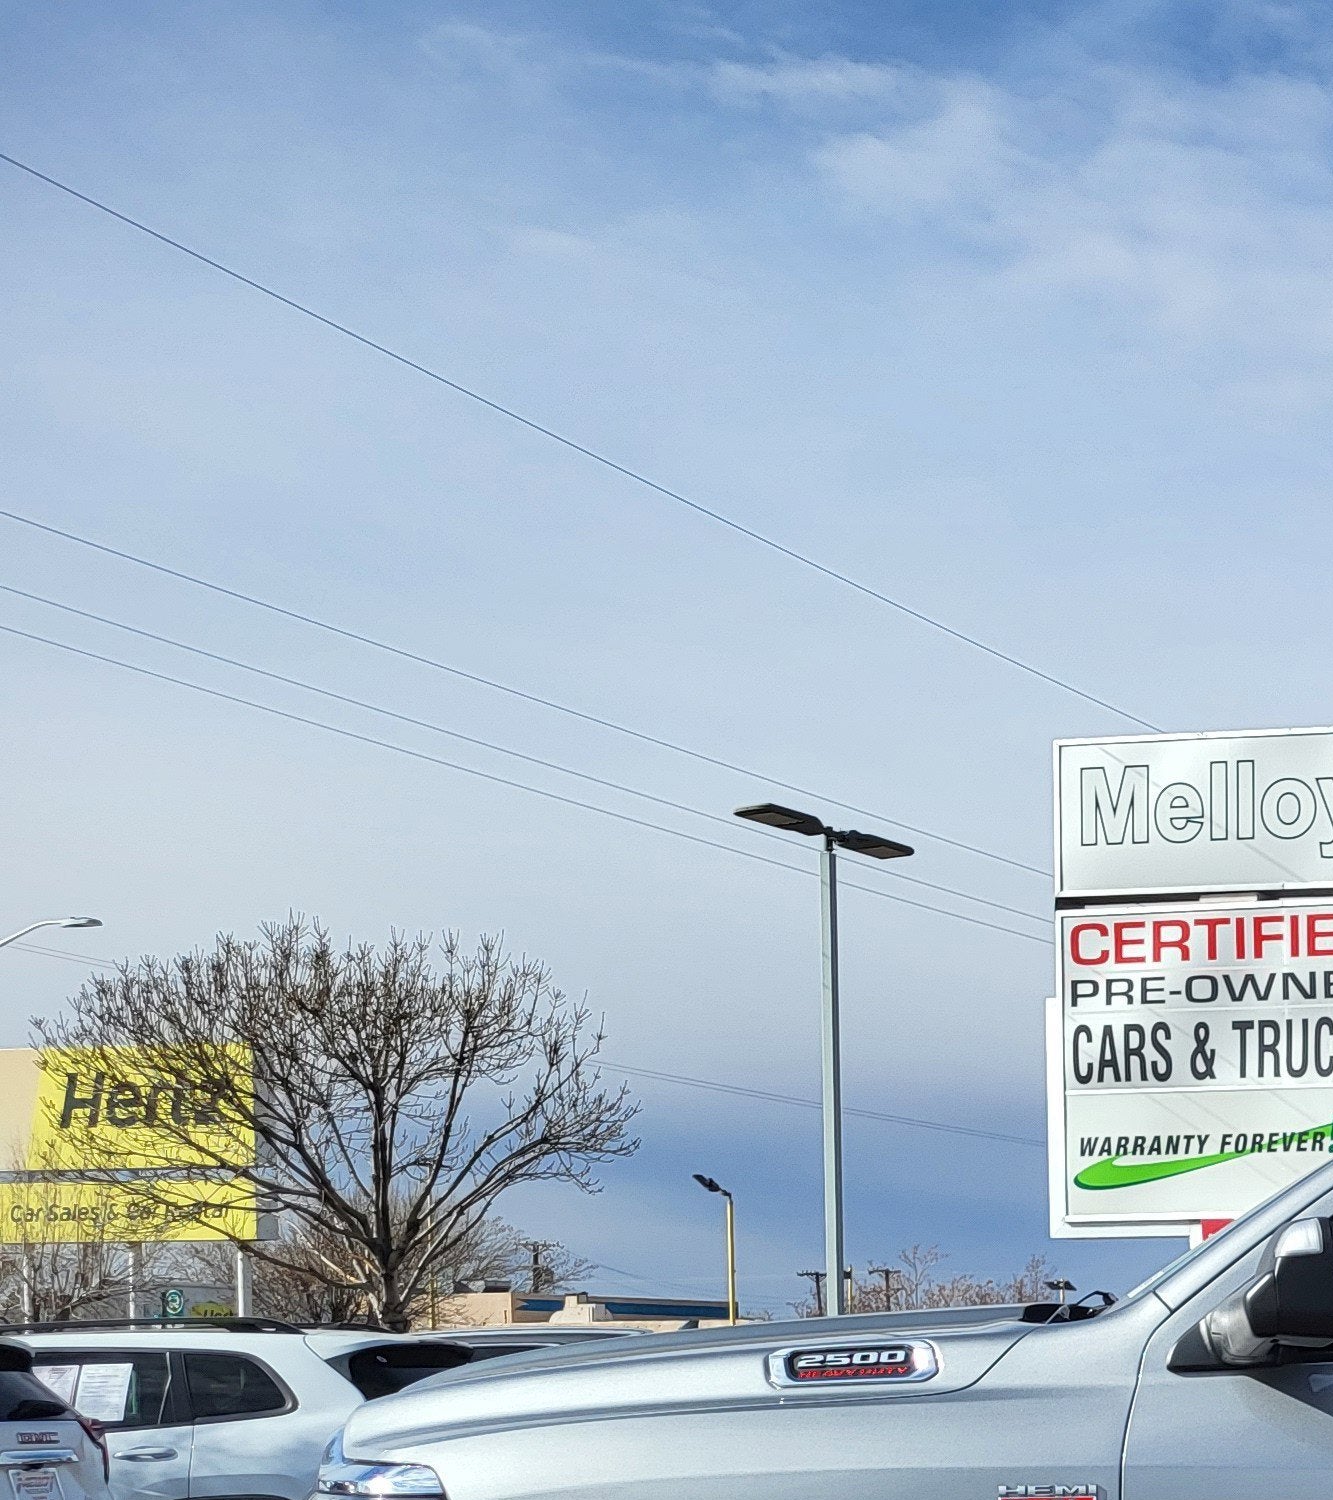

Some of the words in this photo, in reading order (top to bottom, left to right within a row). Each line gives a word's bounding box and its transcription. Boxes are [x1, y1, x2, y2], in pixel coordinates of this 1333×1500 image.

[1072, 1021, 1173, 1085] CARS
[1190, 1021, 1216, 1080] &
[60, 1072, 223, 1129] Hertz
[1080, 1132, 1209, 1157] WARRANTY
[10, 1203, 43, 1223] Car
[46, 1203, 100, 1222] Sales
[797, 1350, 906, 1368] 2500
[998, 1484, 1096, 1496] HEMI
